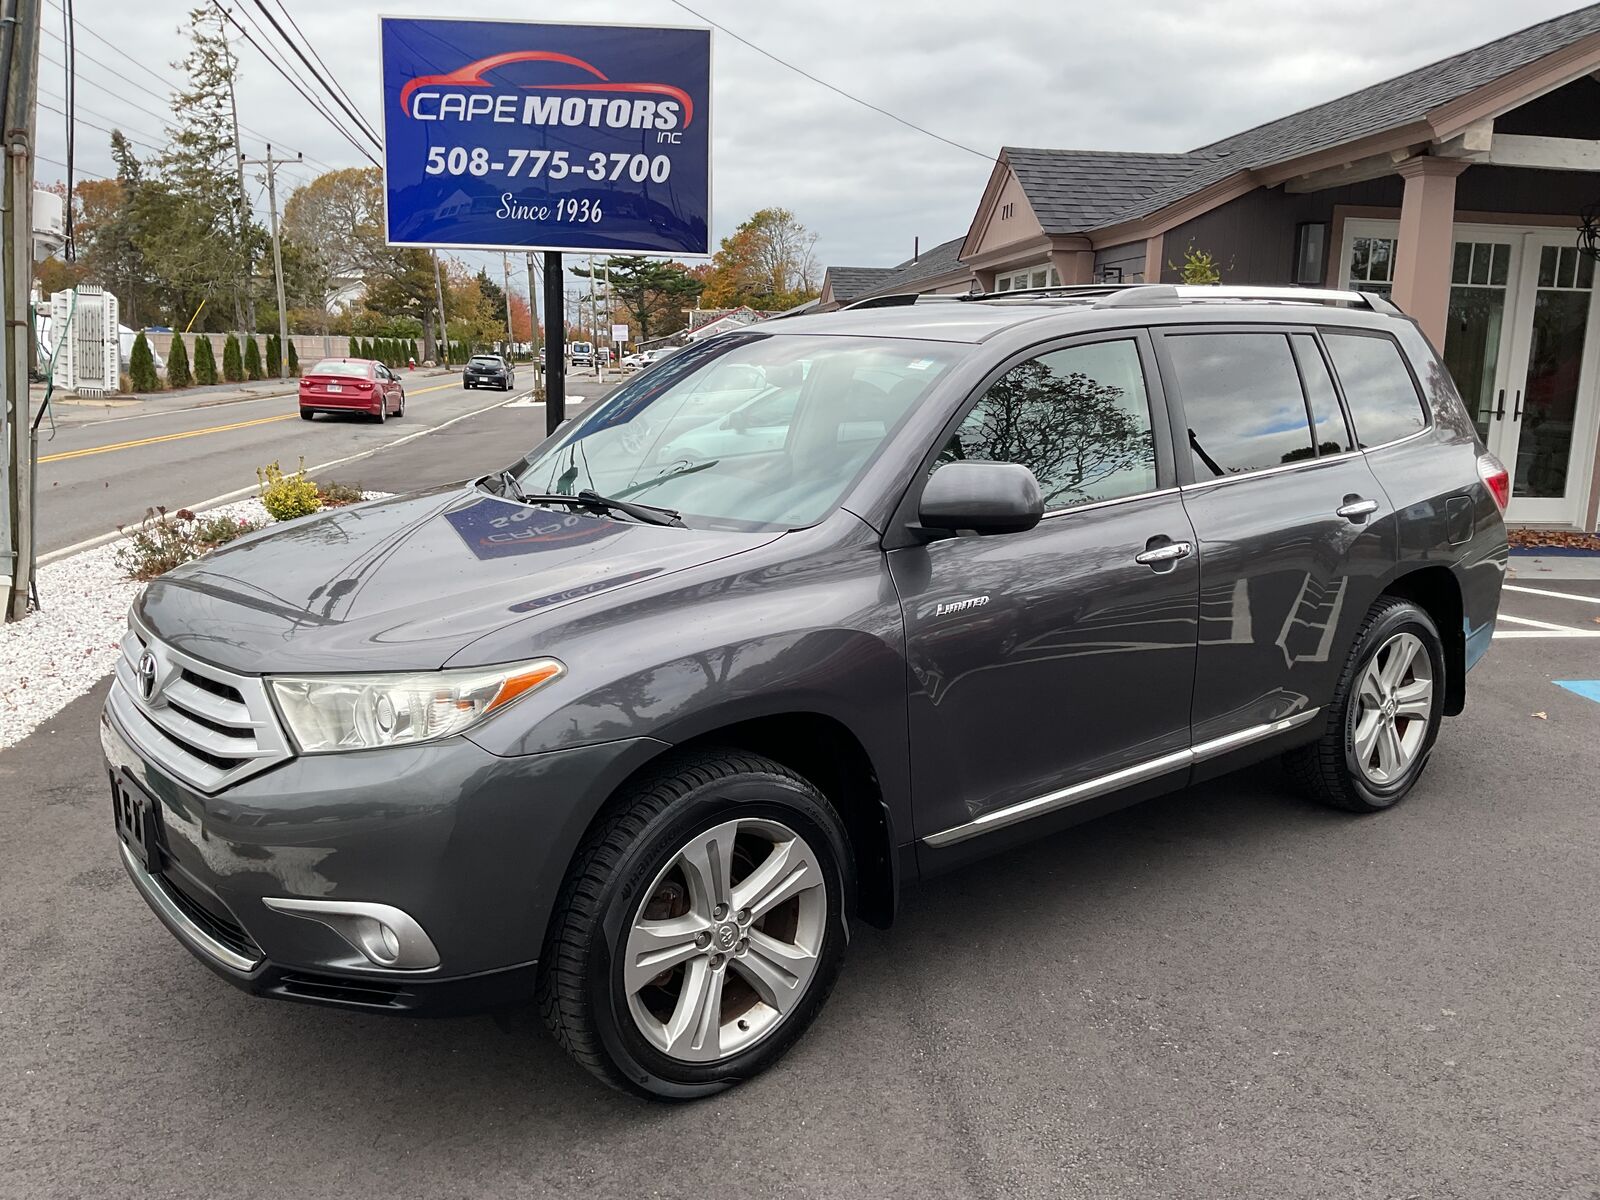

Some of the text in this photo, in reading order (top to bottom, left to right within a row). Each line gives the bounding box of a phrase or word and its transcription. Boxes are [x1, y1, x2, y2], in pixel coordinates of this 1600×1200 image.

[412, 92, 680, 130] CAPE MOTORS
[425, 146, 671, 184] 508-775-3700
[495, 192, 603, 223] Since 1936
[935, 595, 990, 617] LIMITED
